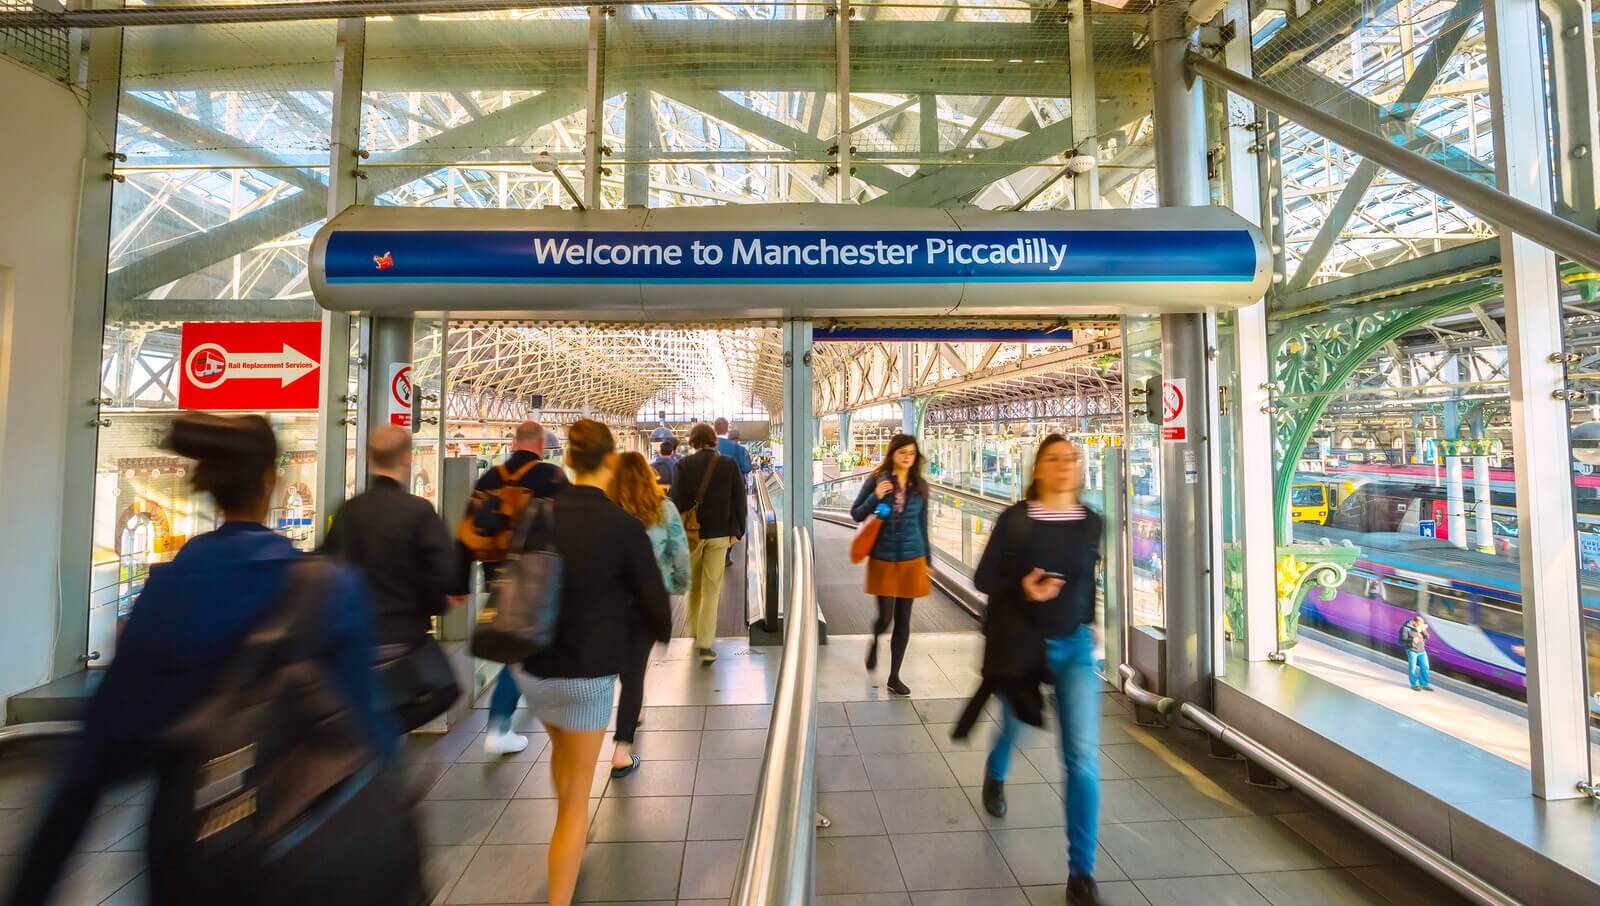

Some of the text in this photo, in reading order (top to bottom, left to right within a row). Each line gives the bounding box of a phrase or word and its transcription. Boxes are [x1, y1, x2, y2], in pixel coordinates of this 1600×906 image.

[533, 237, 1067, 271] Welcome to Manchester Piccadilly
[242, 362, 284, 370] Replacement
